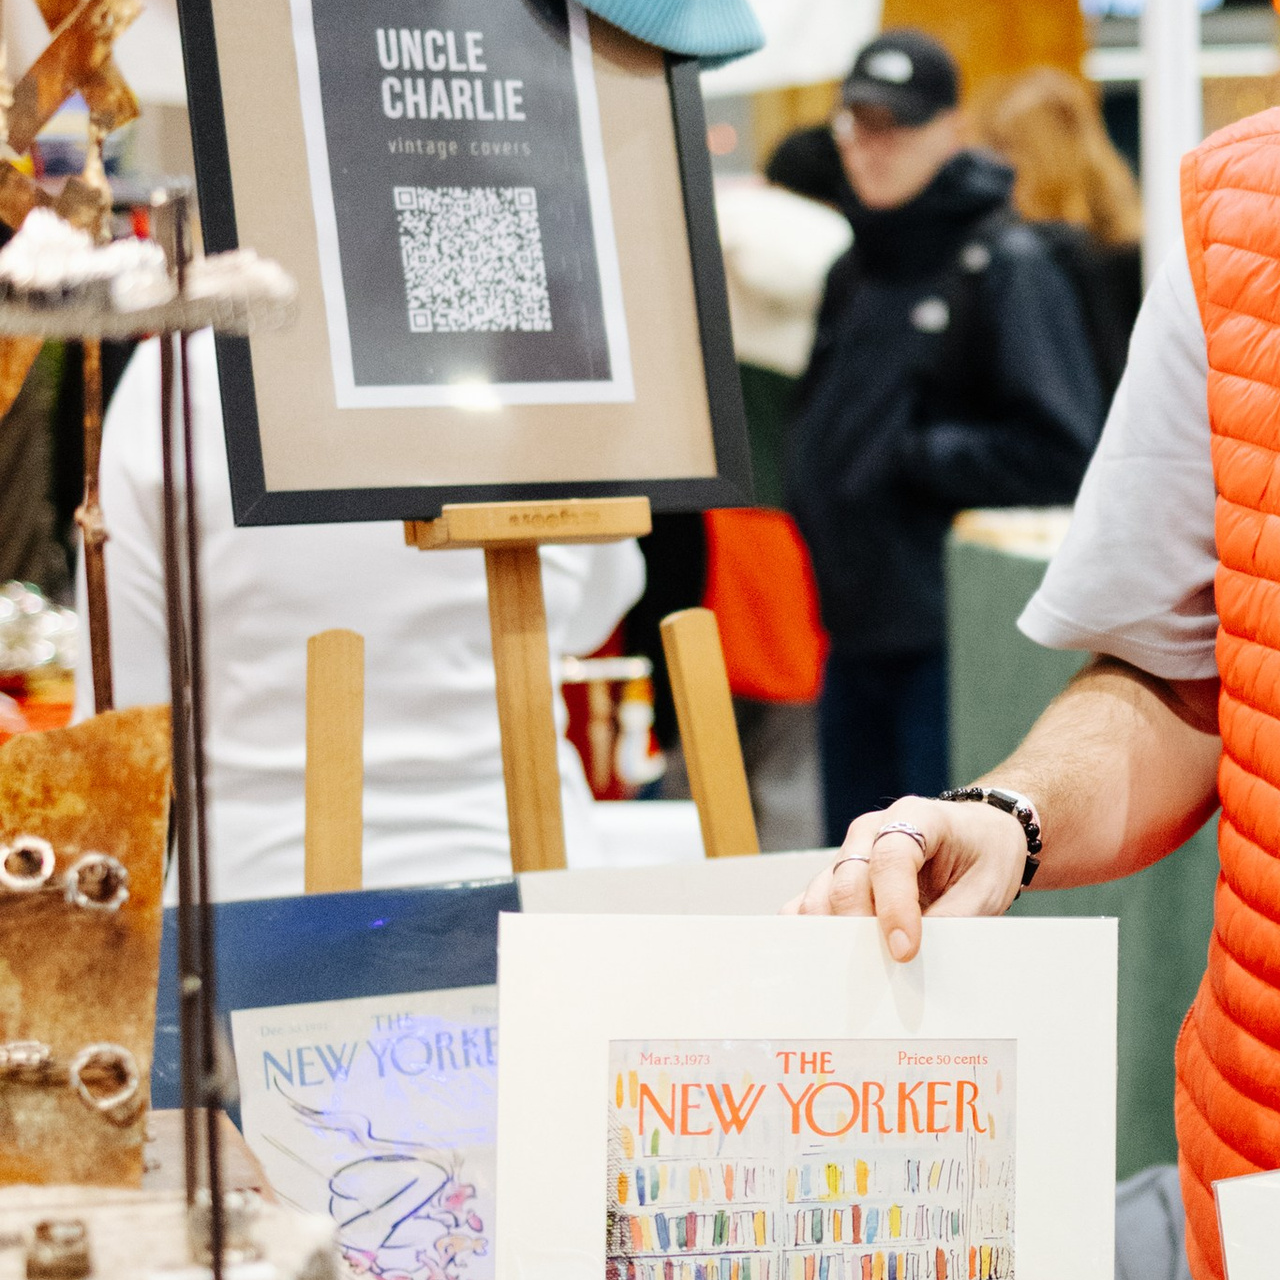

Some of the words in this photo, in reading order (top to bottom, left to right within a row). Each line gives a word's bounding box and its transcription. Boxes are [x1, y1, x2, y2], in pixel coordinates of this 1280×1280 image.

[376, 28, 487, 71] UNCLE
[382, 76, 526, 121] CHARLIE
[388, 137, 458, 160] vintage
[470, 141, 532, 157] covers
[371, 1012, 414, 1032] THE
[263, 1041, 358, 1091] NEW
[776, 1051, 836, 1074] THE
[898, 1051, 934, 1065] Price
[936, 1054, 951, 1065] 50
[953, 1054, 988, 1065] cents
[638, 1082, 767, 1136] NEW
[776, 1080, 987, 1137] YORKER
